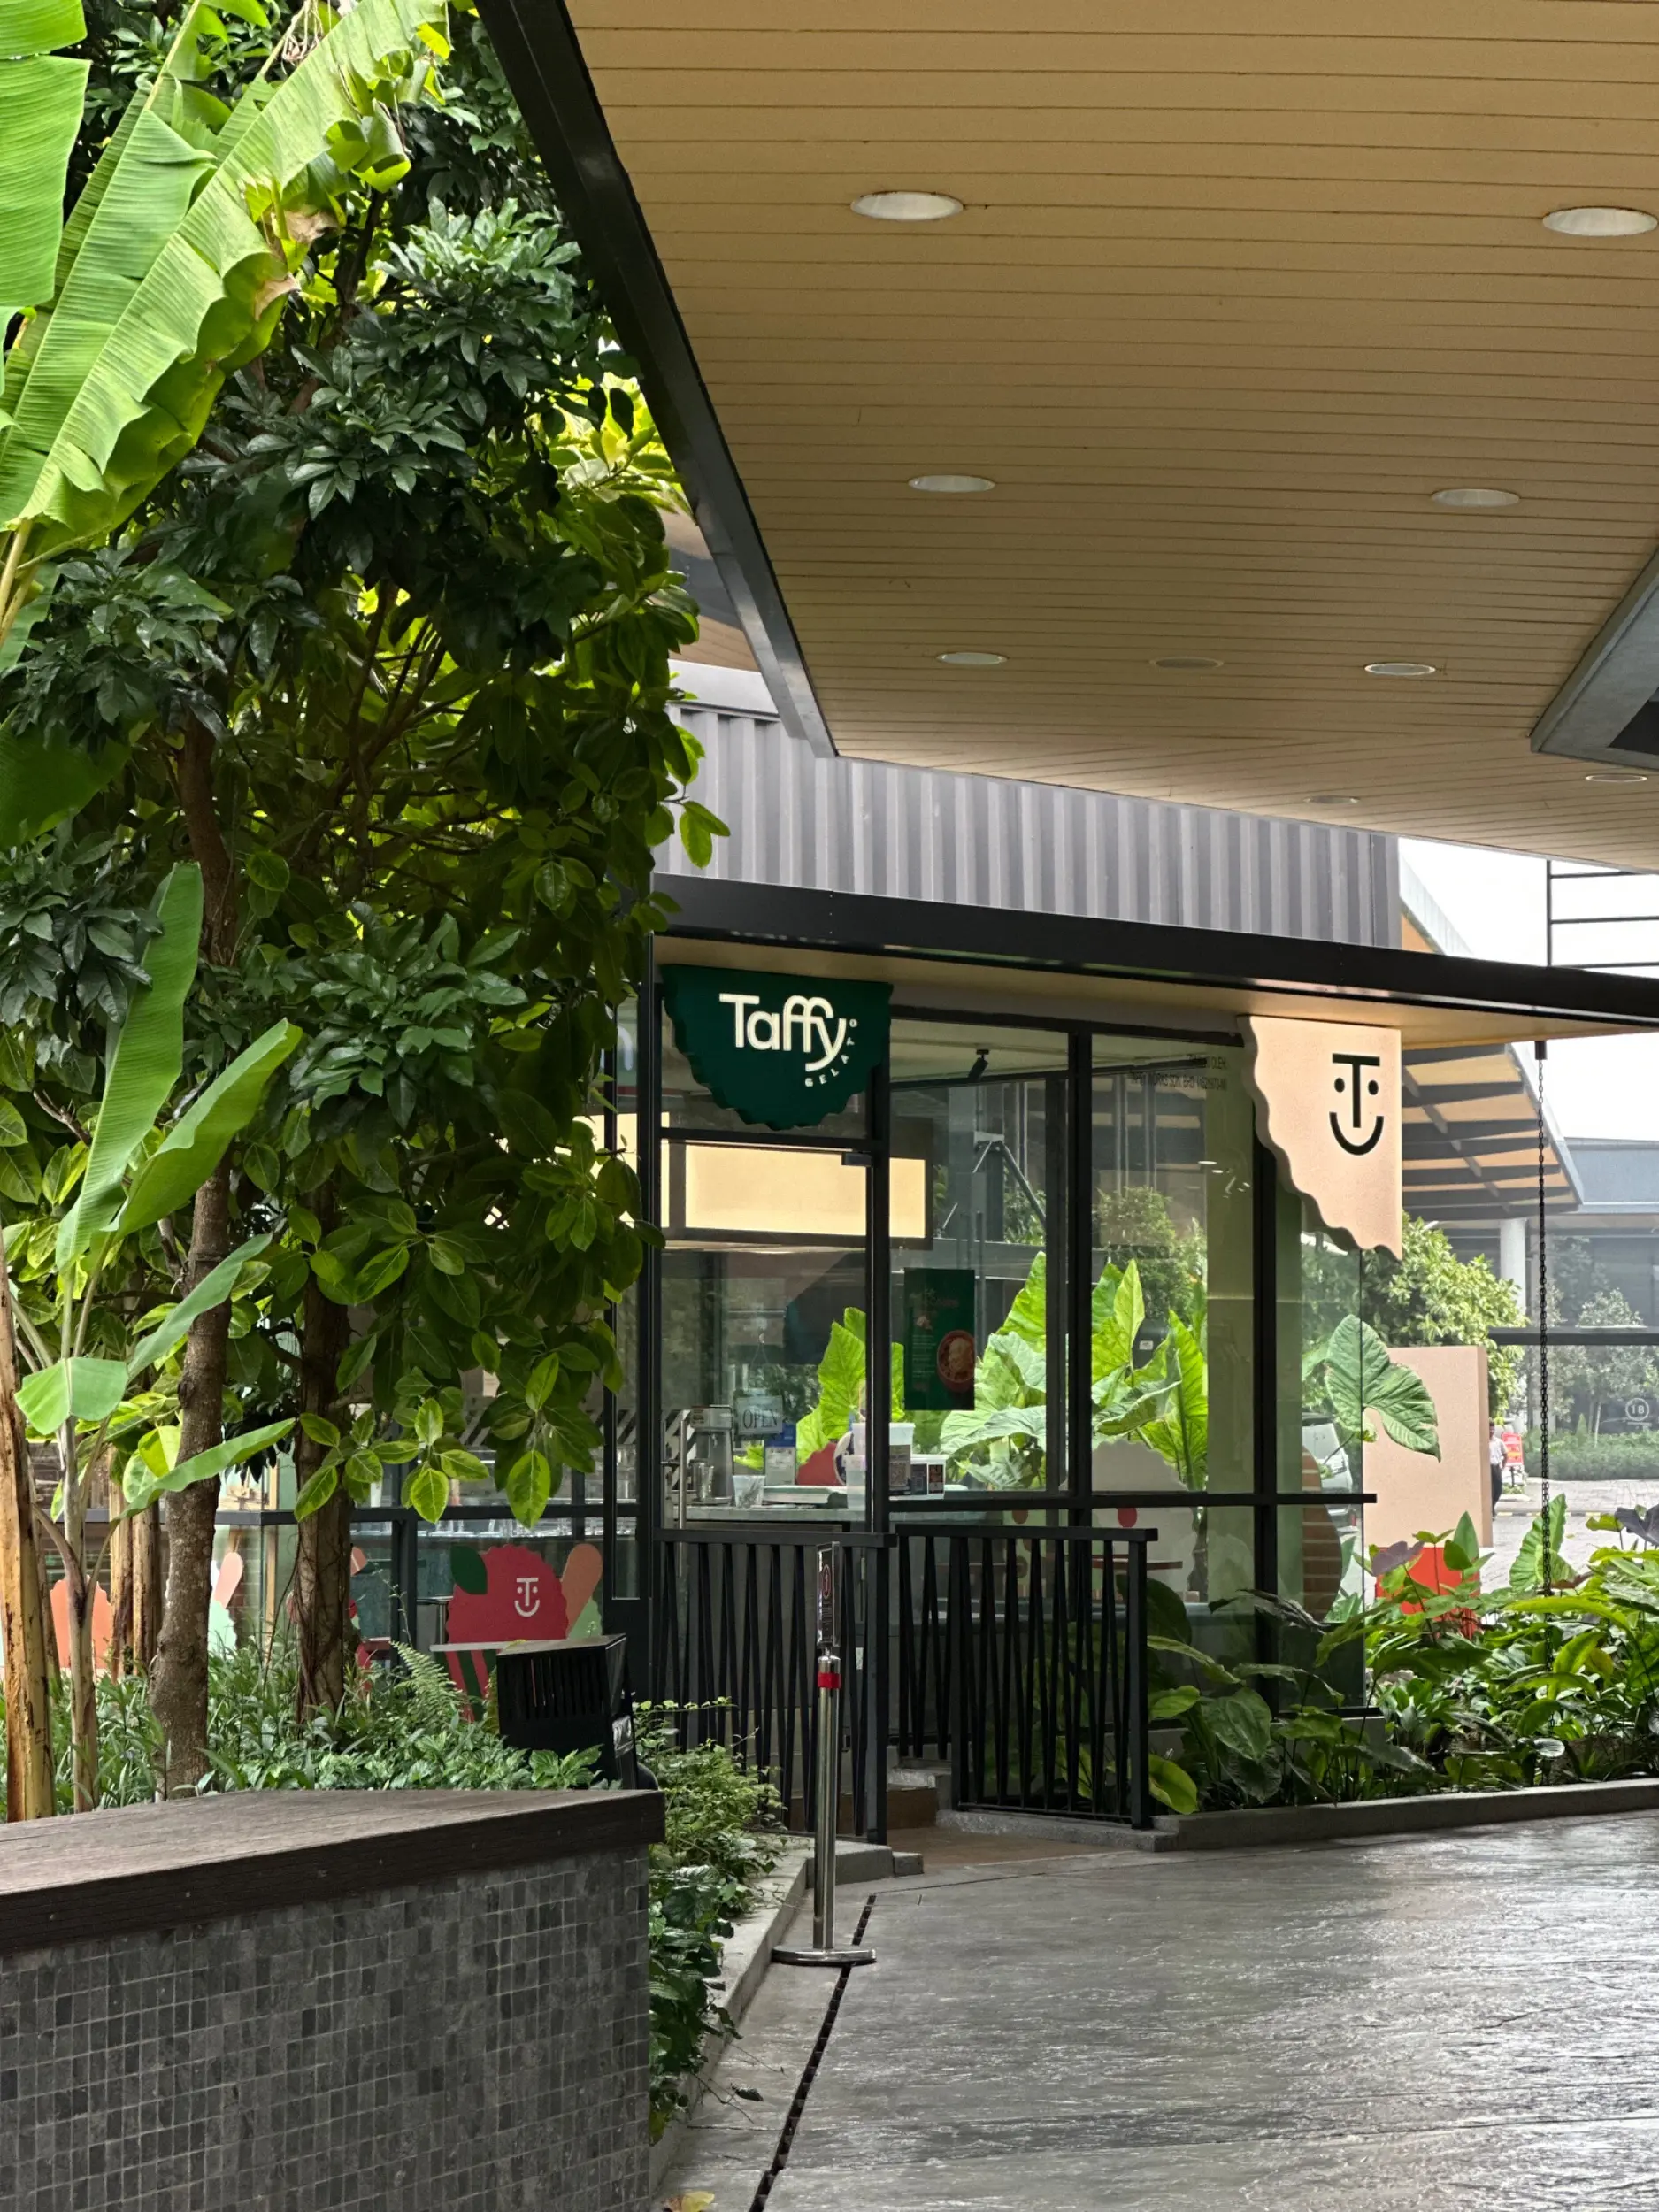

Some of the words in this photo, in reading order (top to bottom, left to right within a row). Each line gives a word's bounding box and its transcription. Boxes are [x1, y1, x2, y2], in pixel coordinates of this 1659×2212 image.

[718, 993, 847, 1072] Taffy
[804, 1018, 858, 1087] GELATO
[743, 1409, 778, 1430] OPEN
[1631, 1404, 1645, 1414] 1B
